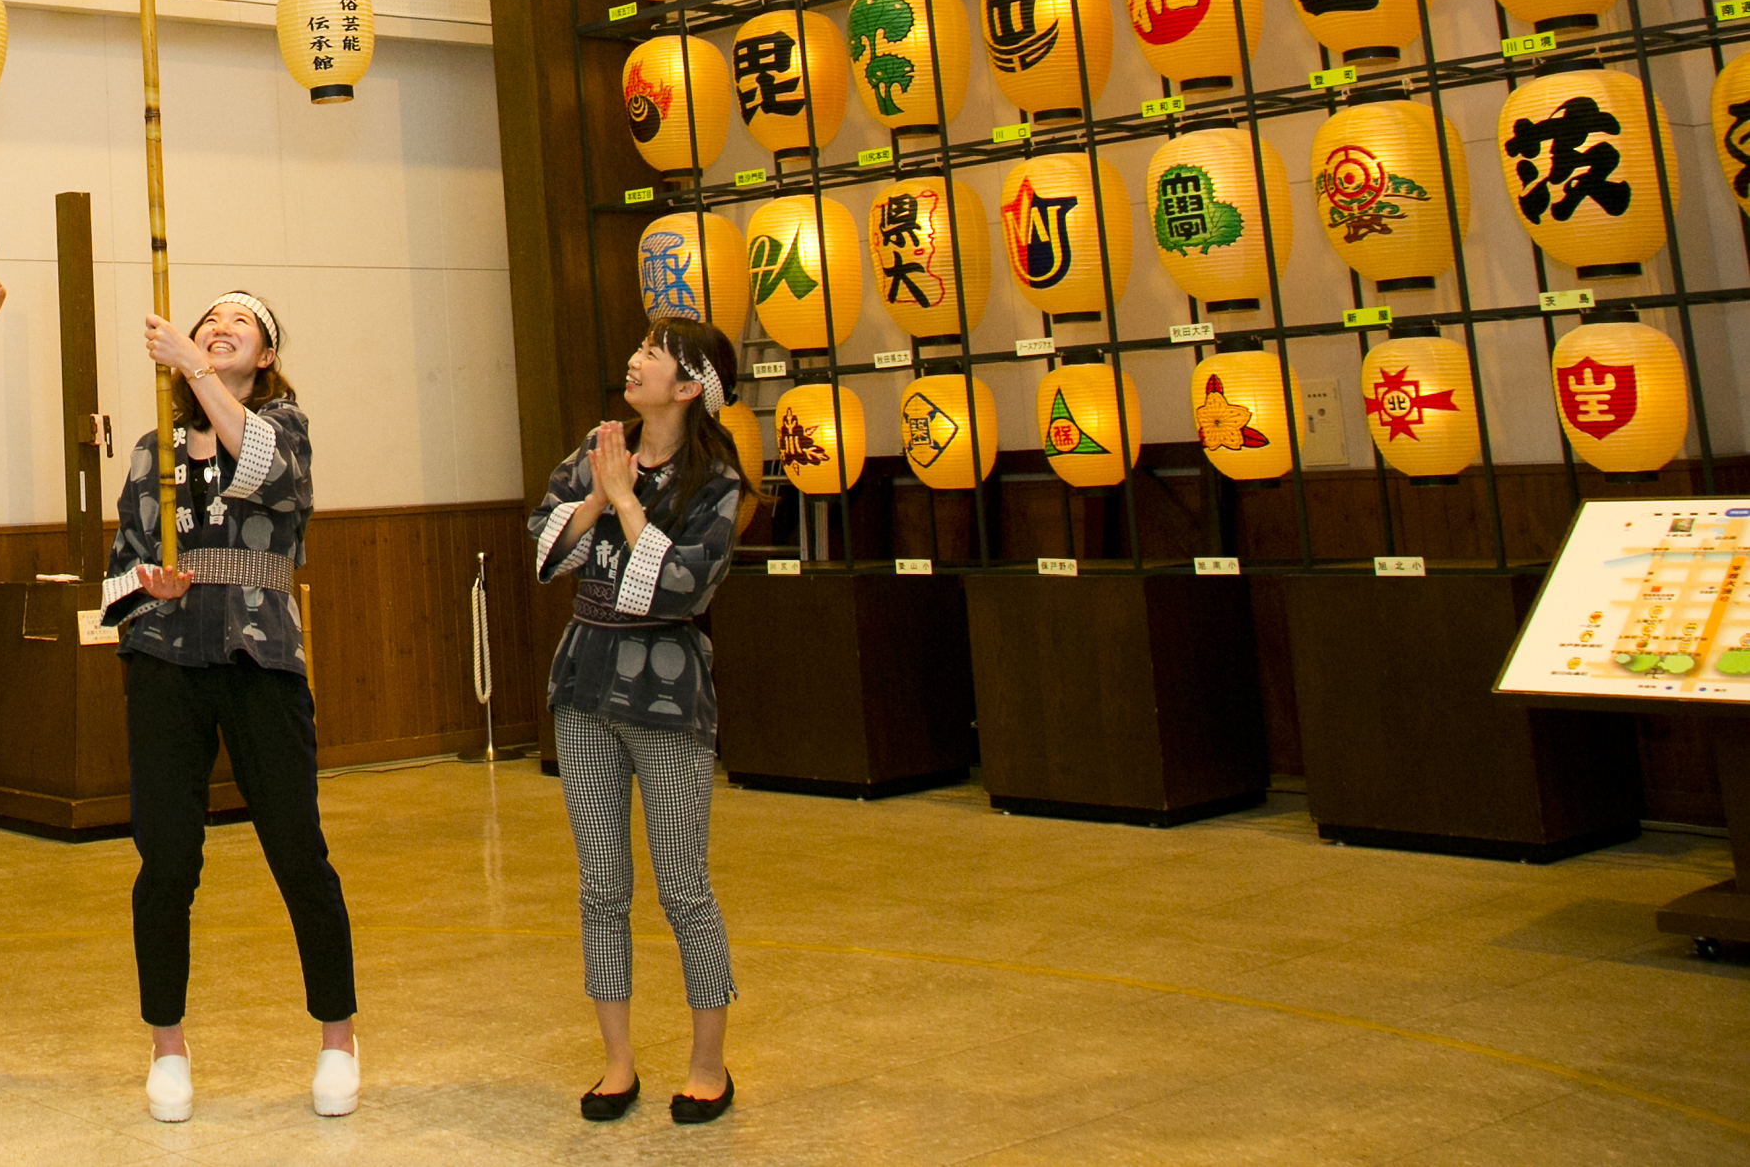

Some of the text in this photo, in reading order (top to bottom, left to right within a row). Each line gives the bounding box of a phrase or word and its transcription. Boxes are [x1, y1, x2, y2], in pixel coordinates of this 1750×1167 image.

[309, 18, 333, 70] 伝承館
[1506, 36, 1552, 53] 川口境
[1313, 69, 1353, 86] 登町
[1145, 99, 1182, 114] 共和町
[860, 150, 890, 163] 川尻本町
[880, 194, 930, 308] 県大
[1545, 293, 1590, 307] 茨島
[1346, 310, 1389, 323] 新屋
[1173, 325, 1211, 338] 秋田大学
[1378, 561, 1422, 571] 旭北小
